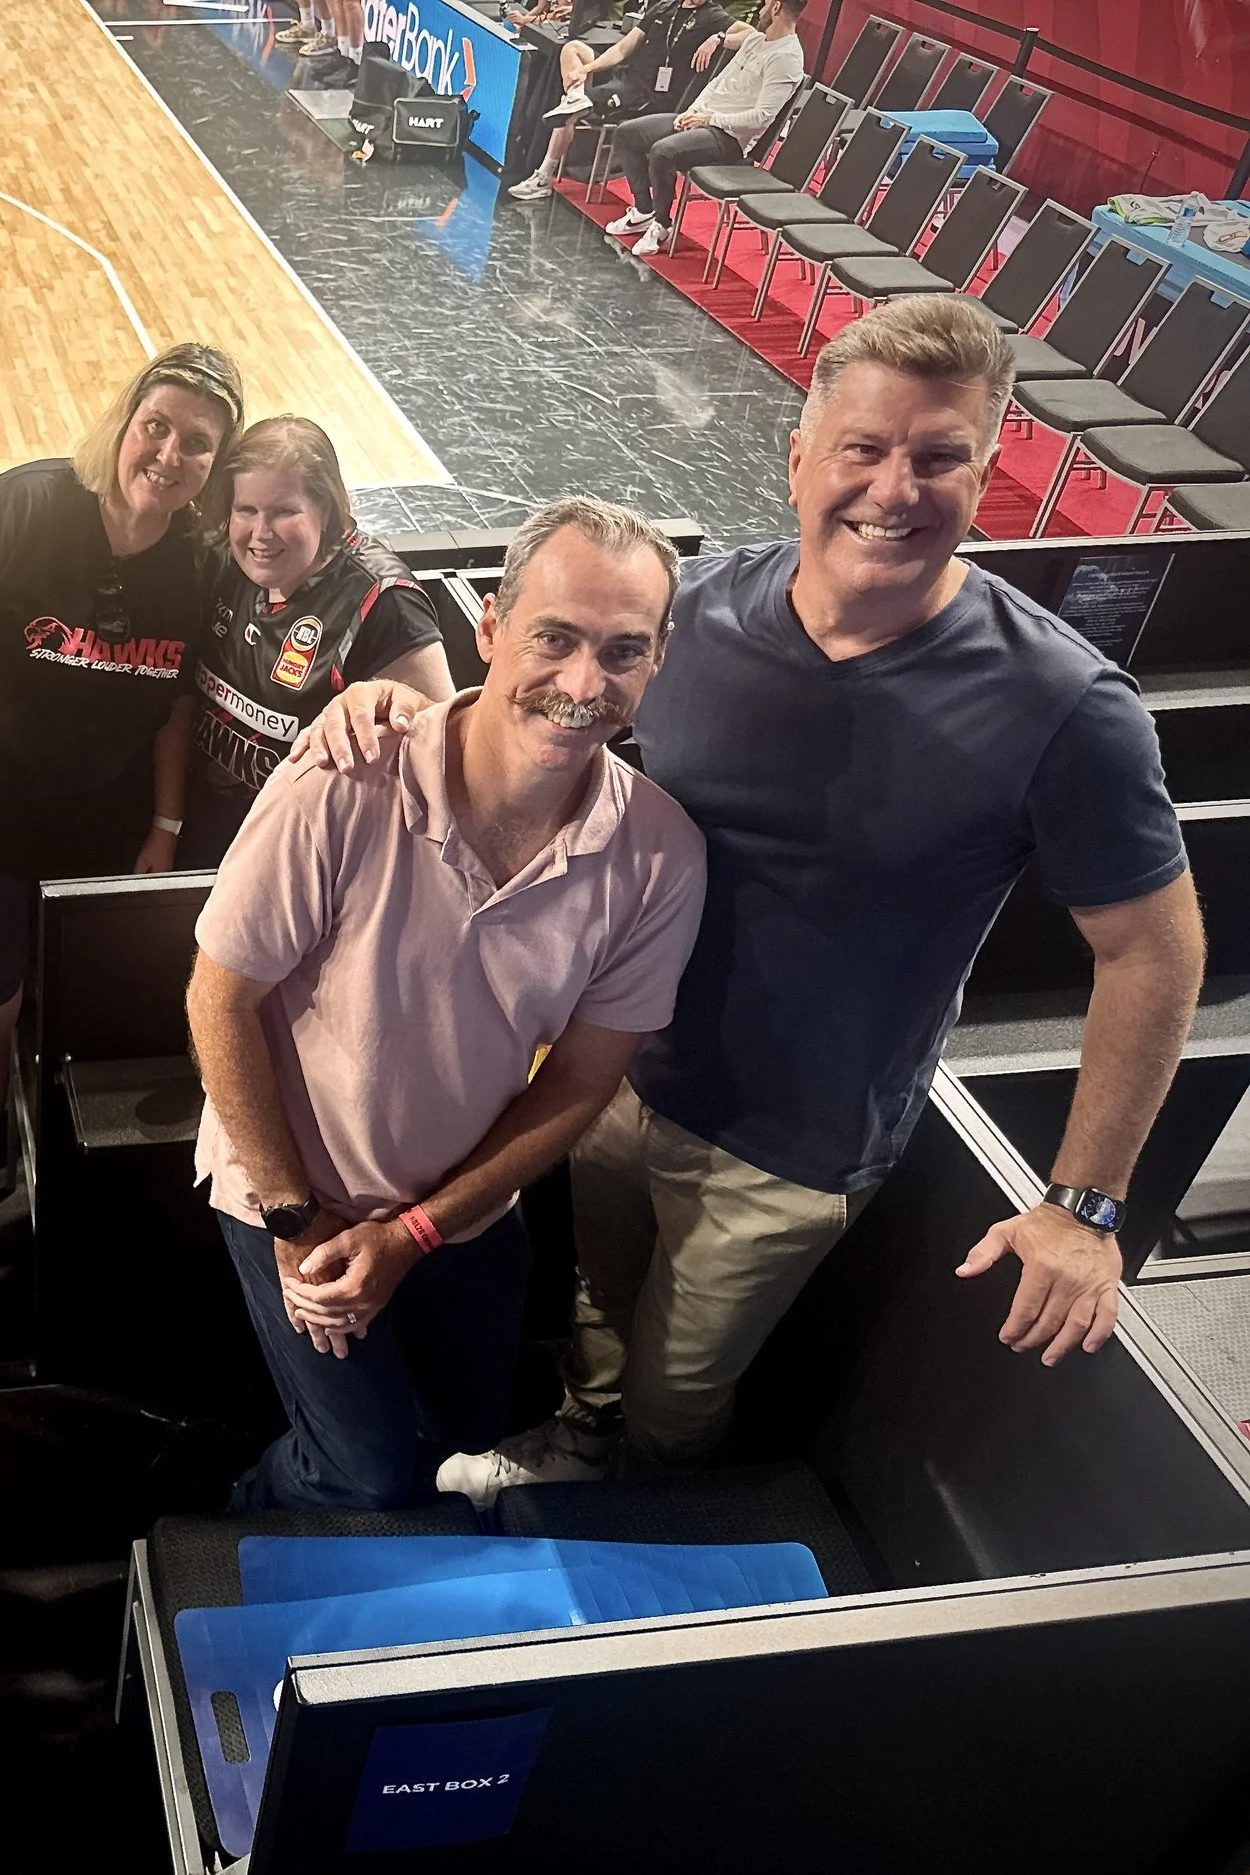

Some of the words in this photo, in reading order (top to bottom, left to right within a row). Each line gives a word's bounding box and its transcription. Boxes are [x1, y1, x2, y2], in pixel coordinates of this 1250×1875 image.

[408, 116, 444, 128] HART
[28, 648, 89, 670] STRONGER
[91, 659, 133, 674] LOUDER
[134, 664, 180, 679] TOGETHER
[69, 627, 186, 669] HAWKS
[196, 667, 295, 737] ppermoney
[382, 1782, 440, 1795] EAST
[444, 1777, 494, 1792] BOX
[497, 1774, 510, 1784] 2
